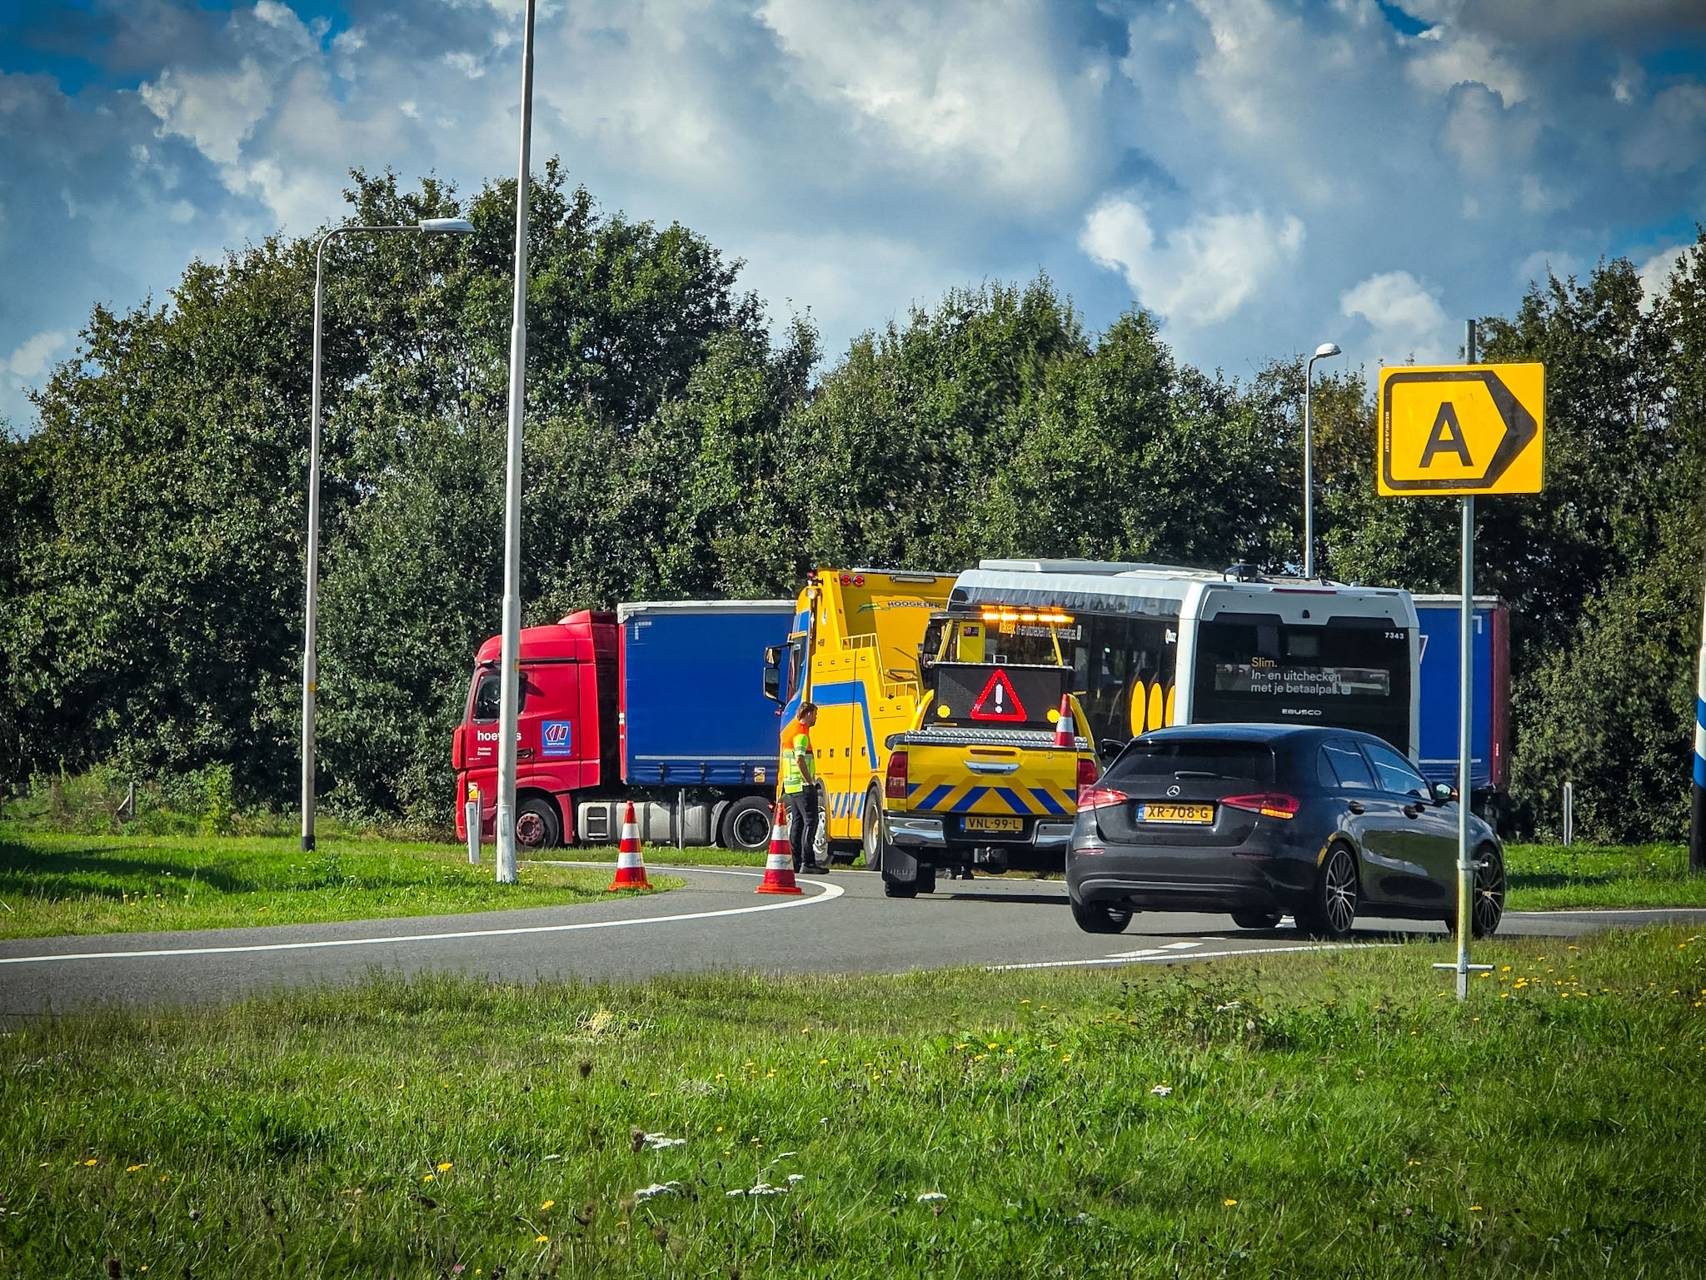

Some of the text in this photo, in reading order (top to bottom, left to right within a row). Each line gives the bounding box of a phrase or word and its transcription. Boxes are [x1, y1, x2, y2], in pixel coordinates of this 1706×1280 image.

[1418, 401, 1474, 468] A
[1384, 632, 1405, 640] 7343
[1251, 657, 1278, 668] Slim.
[1267, 672, 1281, 680] en
[1283, 669, 1341, 682] uitchecken
[1250, 682, 1272, 692] met
[1273, 682, 1284, 695] je
[1281, 708, 1322, 716] EBUSCO
[1148, 805, 1209, 819] XR-708-G
